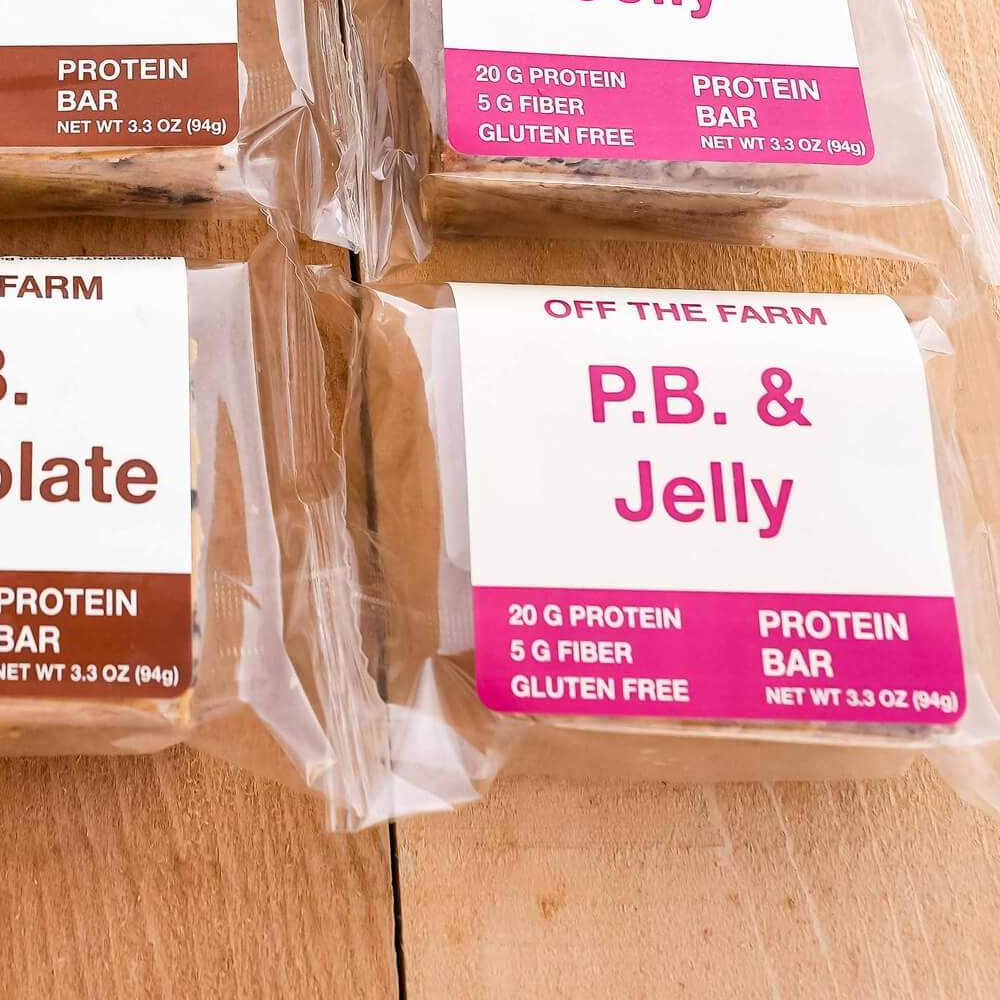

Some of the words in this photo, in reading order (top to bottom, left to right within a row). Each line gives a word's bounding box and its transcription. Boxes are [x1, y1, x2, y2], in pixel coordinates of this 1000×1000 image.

[58, 58, 188, 81] PROTEIN
[57, 89, 118, 112] BAR
[692, 75, 820, 101] PROTEIN
[57, 120, 92, 134] NET
[95, 119, 124, 133] WT
[127, 119, 153, 133] 3.3
[157, 118, 182, 133] OZ
[186, 118, 227, 135] (94g)
[696, 105, 758, 128] BAR
[478, 123, 570, 144] GLUTEN
[576, 127, 635, 146] FREE
[543, 299, 617, 320] OFF
[626, 301, 708, 322] THE
[715, 304, 827, 326] FARM
[588, 364, 727, 426] P.B.
[756, 366, 813, 427] &
[614, 459, 794, 539] Jelly
[508, 603, 538, 626] 20
[543, 604, 563, 627] G
[569, 605, 682, 629] PROTEIN
[758, 609, 909, 641] PROTEIN
[510, 639, 526, 662] 5
[531, 640, 551, 662] G
[557, 640, 633, 664] FIBER
[761, 648, 834, 678] BAR
[35, 663, 66, 681] WT
[70, 663, 98, 682] 3.3
[102, 664, 130, 683] OZ
[134, 664, 179, 687] (94g)
[510, 675, 616, 700] GLUTEN
[622, 677, 690, 702] FREE
[765, 686, 806, 706] NET
[809, 687, 842, 706] WT
[846, 688, 876, 707] 3.3
[878, 689, 909, 708] OZ
[912, 690, 959, 713] (94g)
